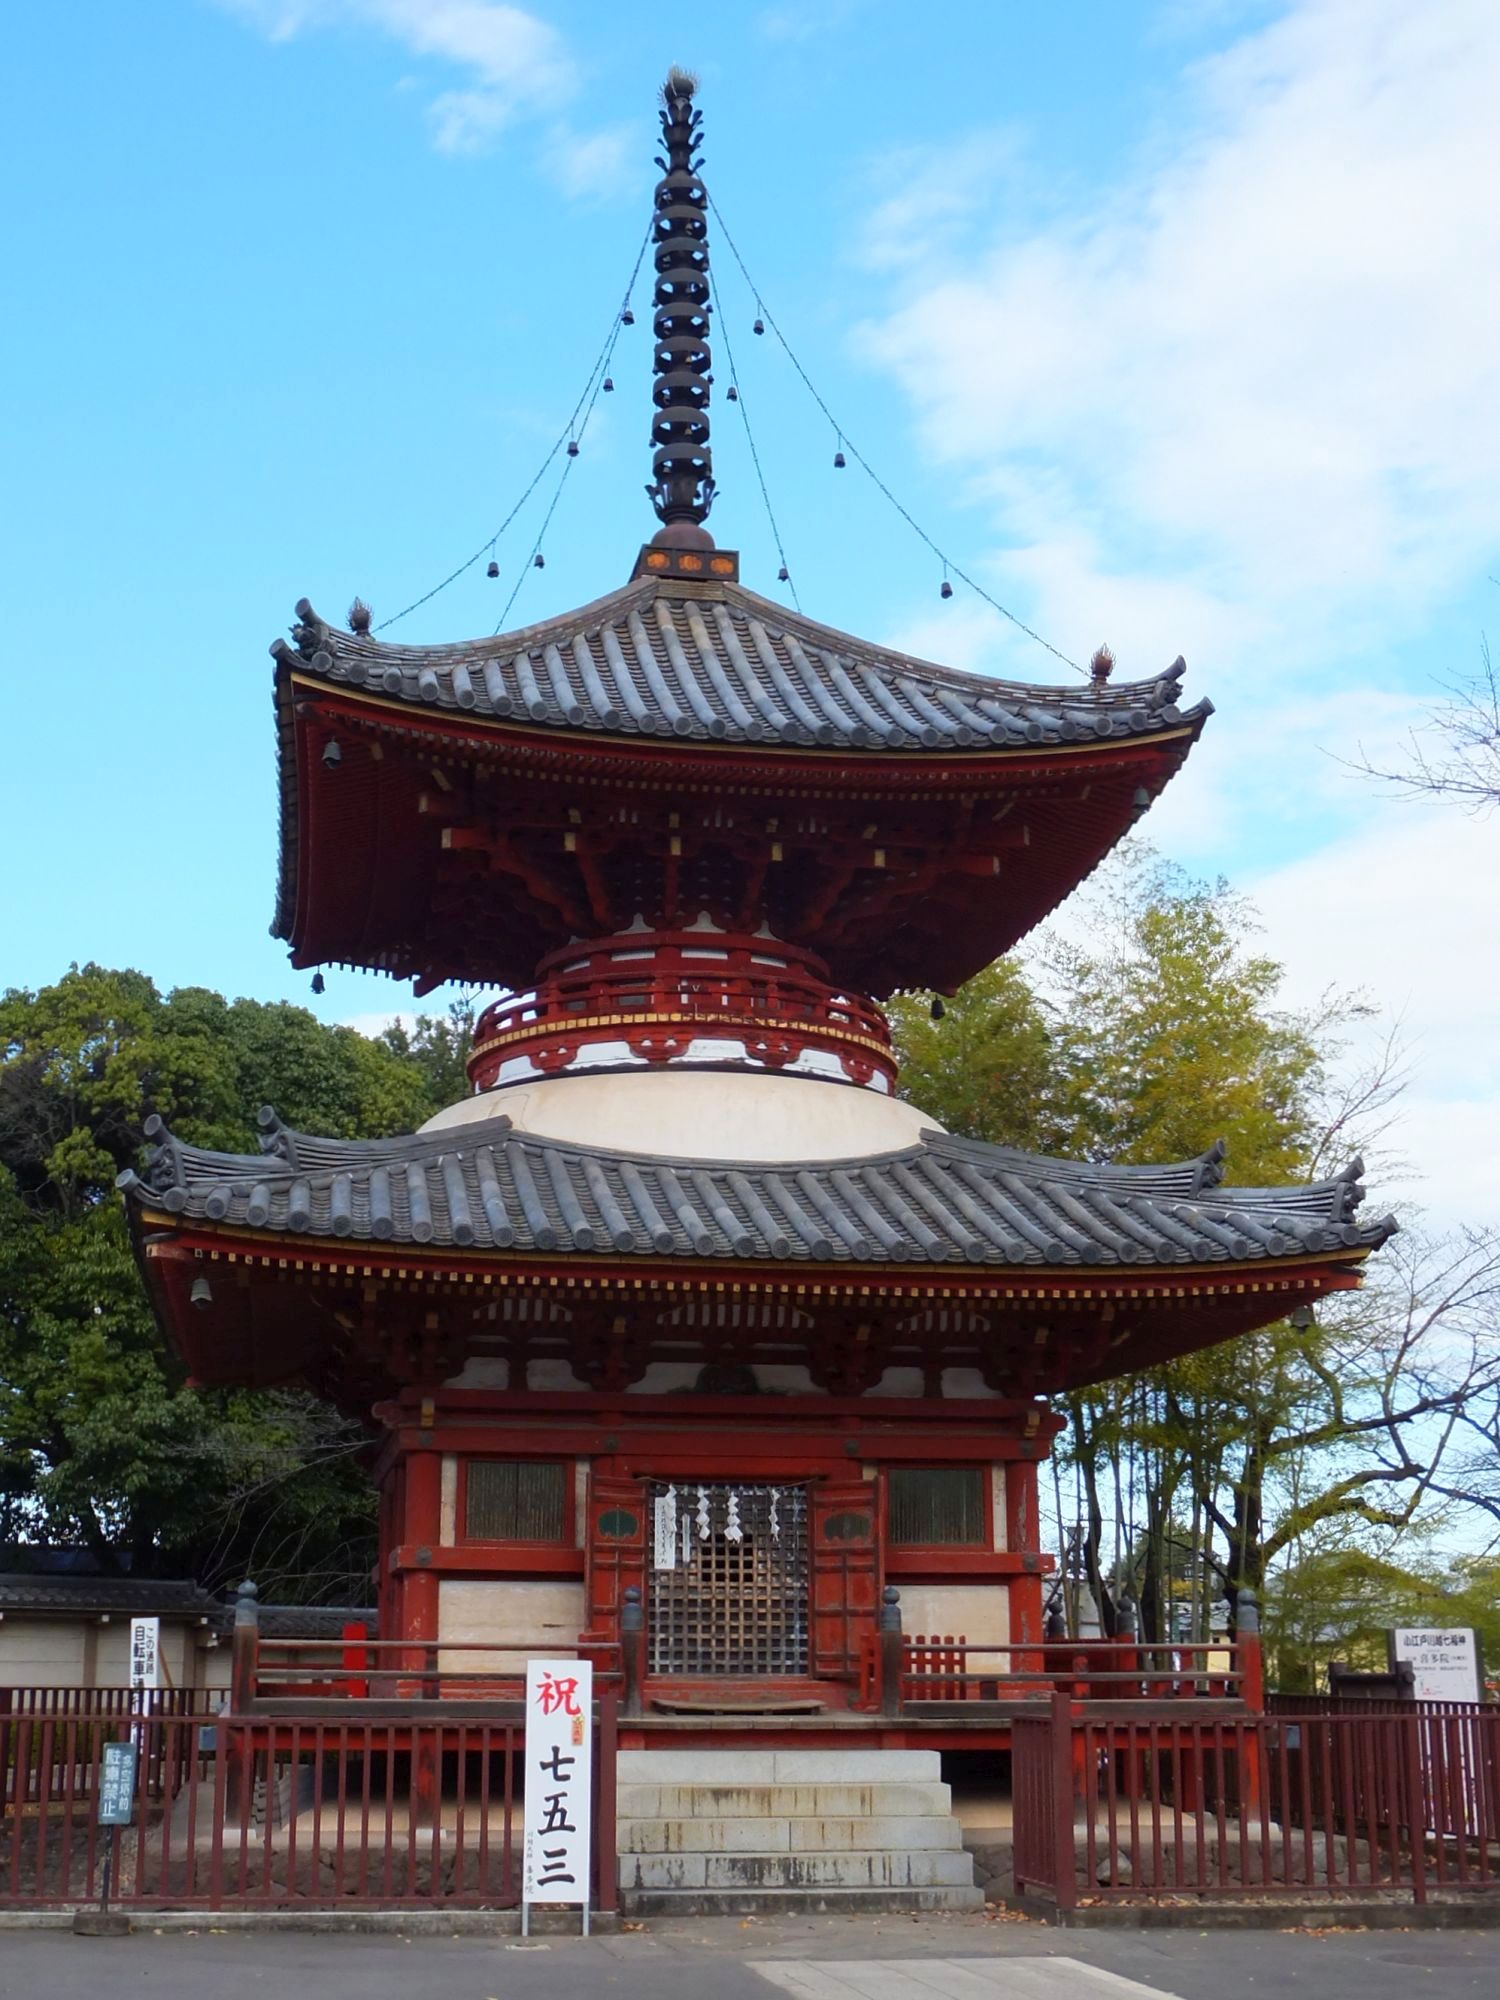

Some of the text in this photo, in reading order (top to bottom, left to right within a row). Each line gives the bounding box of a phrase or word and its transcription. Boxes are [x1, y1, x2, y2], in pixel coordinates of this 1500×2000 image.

[1420, 1653, 1449, 1664] 喜多院
[535, 1672, 581, 1716] 祝
[102, 1748, 121, 1817] 駐車禁止
[537, 1745, 576, 1887] 七五三
